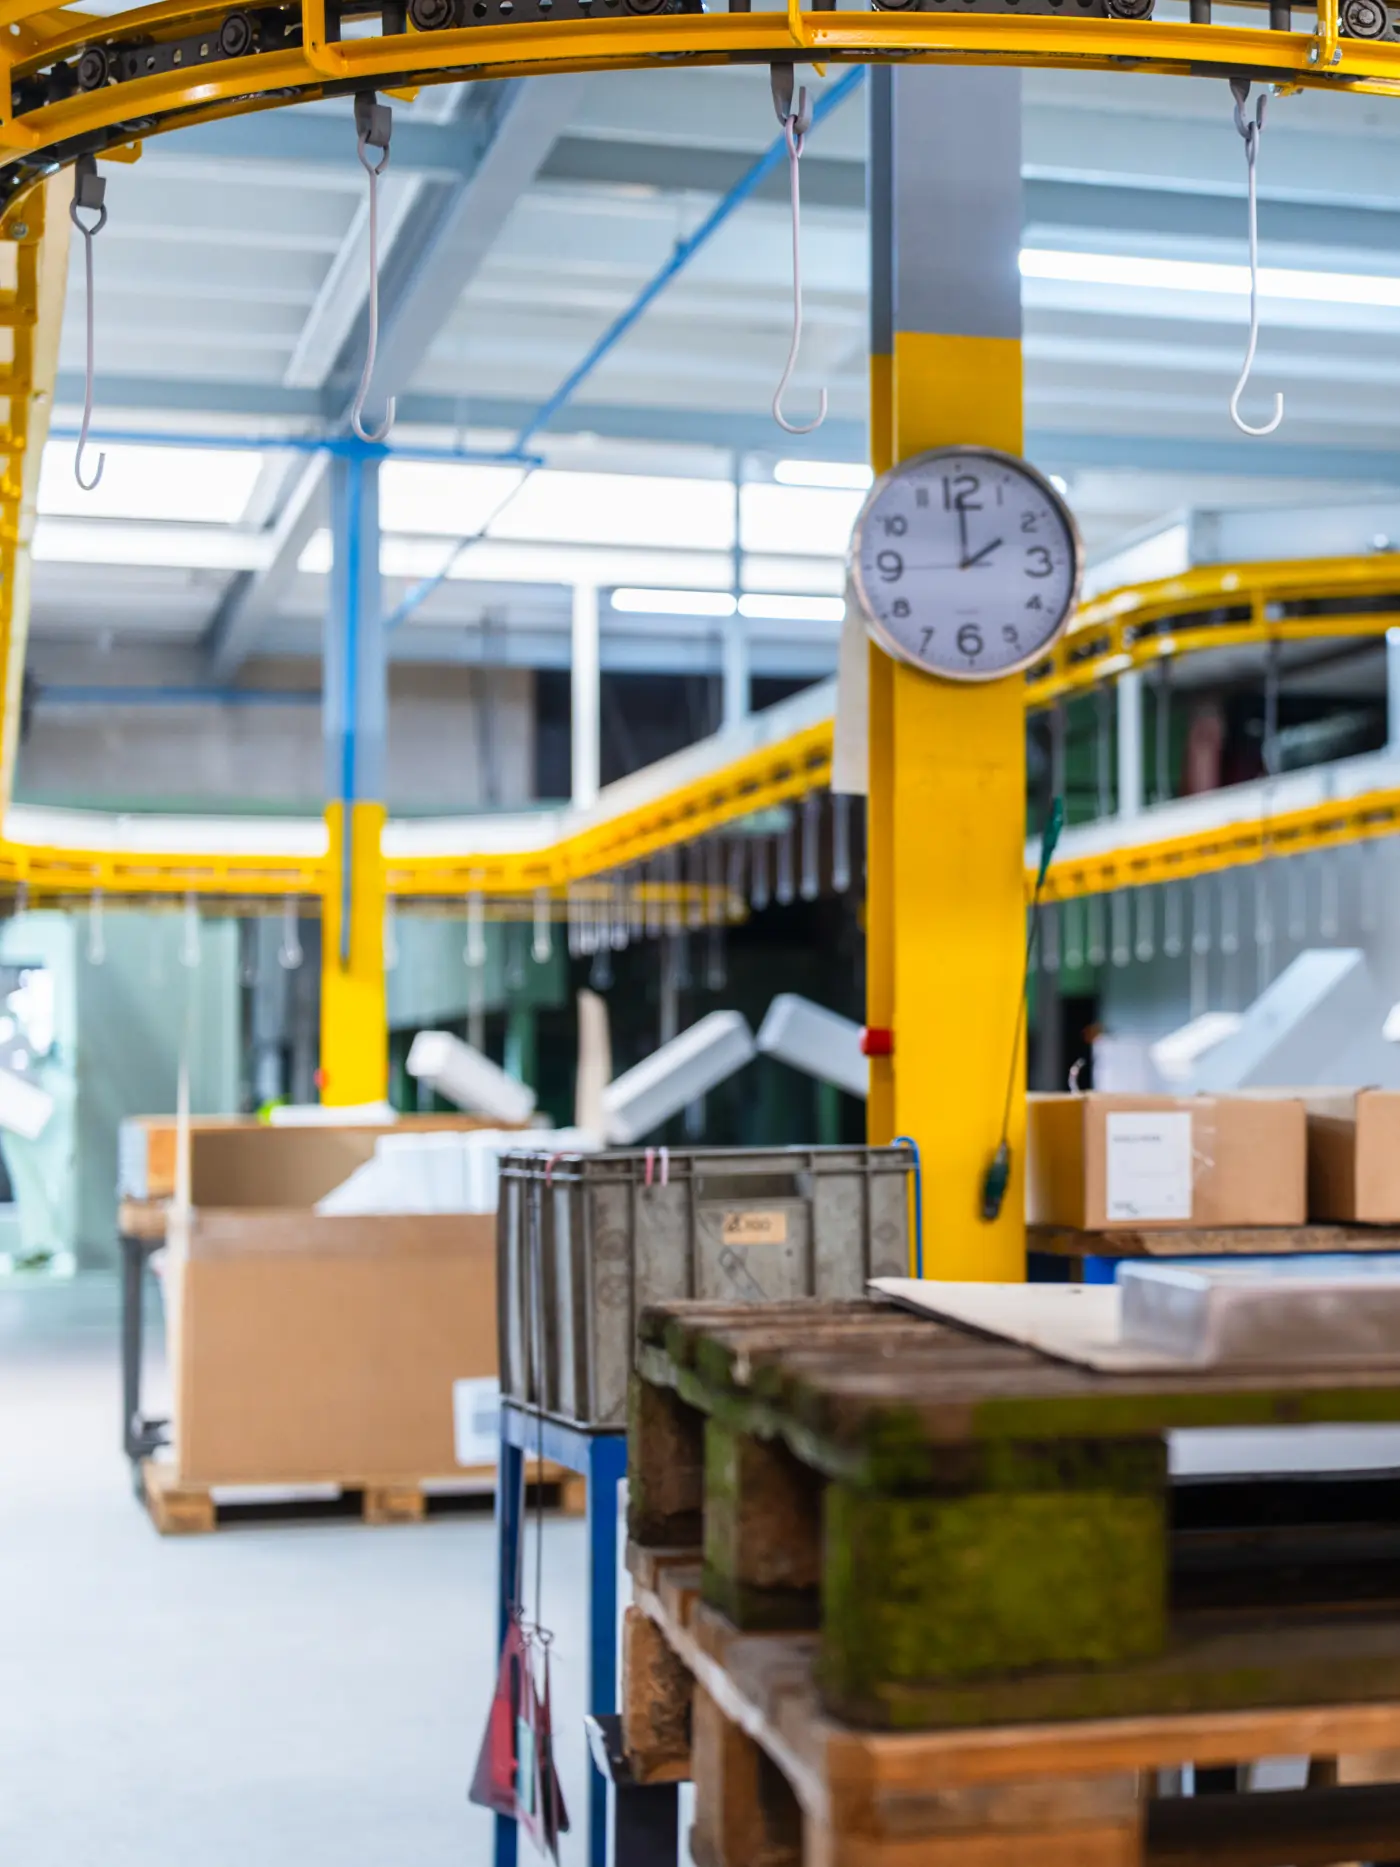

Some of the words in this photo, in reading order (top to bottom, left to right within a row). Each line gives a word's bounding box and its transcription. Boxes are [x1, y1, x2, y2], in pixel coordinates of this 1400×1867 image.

[942, 475, 983, 511] 12
[884, 515, 908, 537] 10
[1020, 511, 1038, 533] 2
[876, 550, 903, 583] 9
[1024, 546, 1053, 579] 3
[892, 598, 911, 618] 8
[1025, 595, 1042, 611] 4
[920, 625, 936, 649] 7
[956, 623, 984, 657] 6
[1002, 624, 1019, 644] 5
